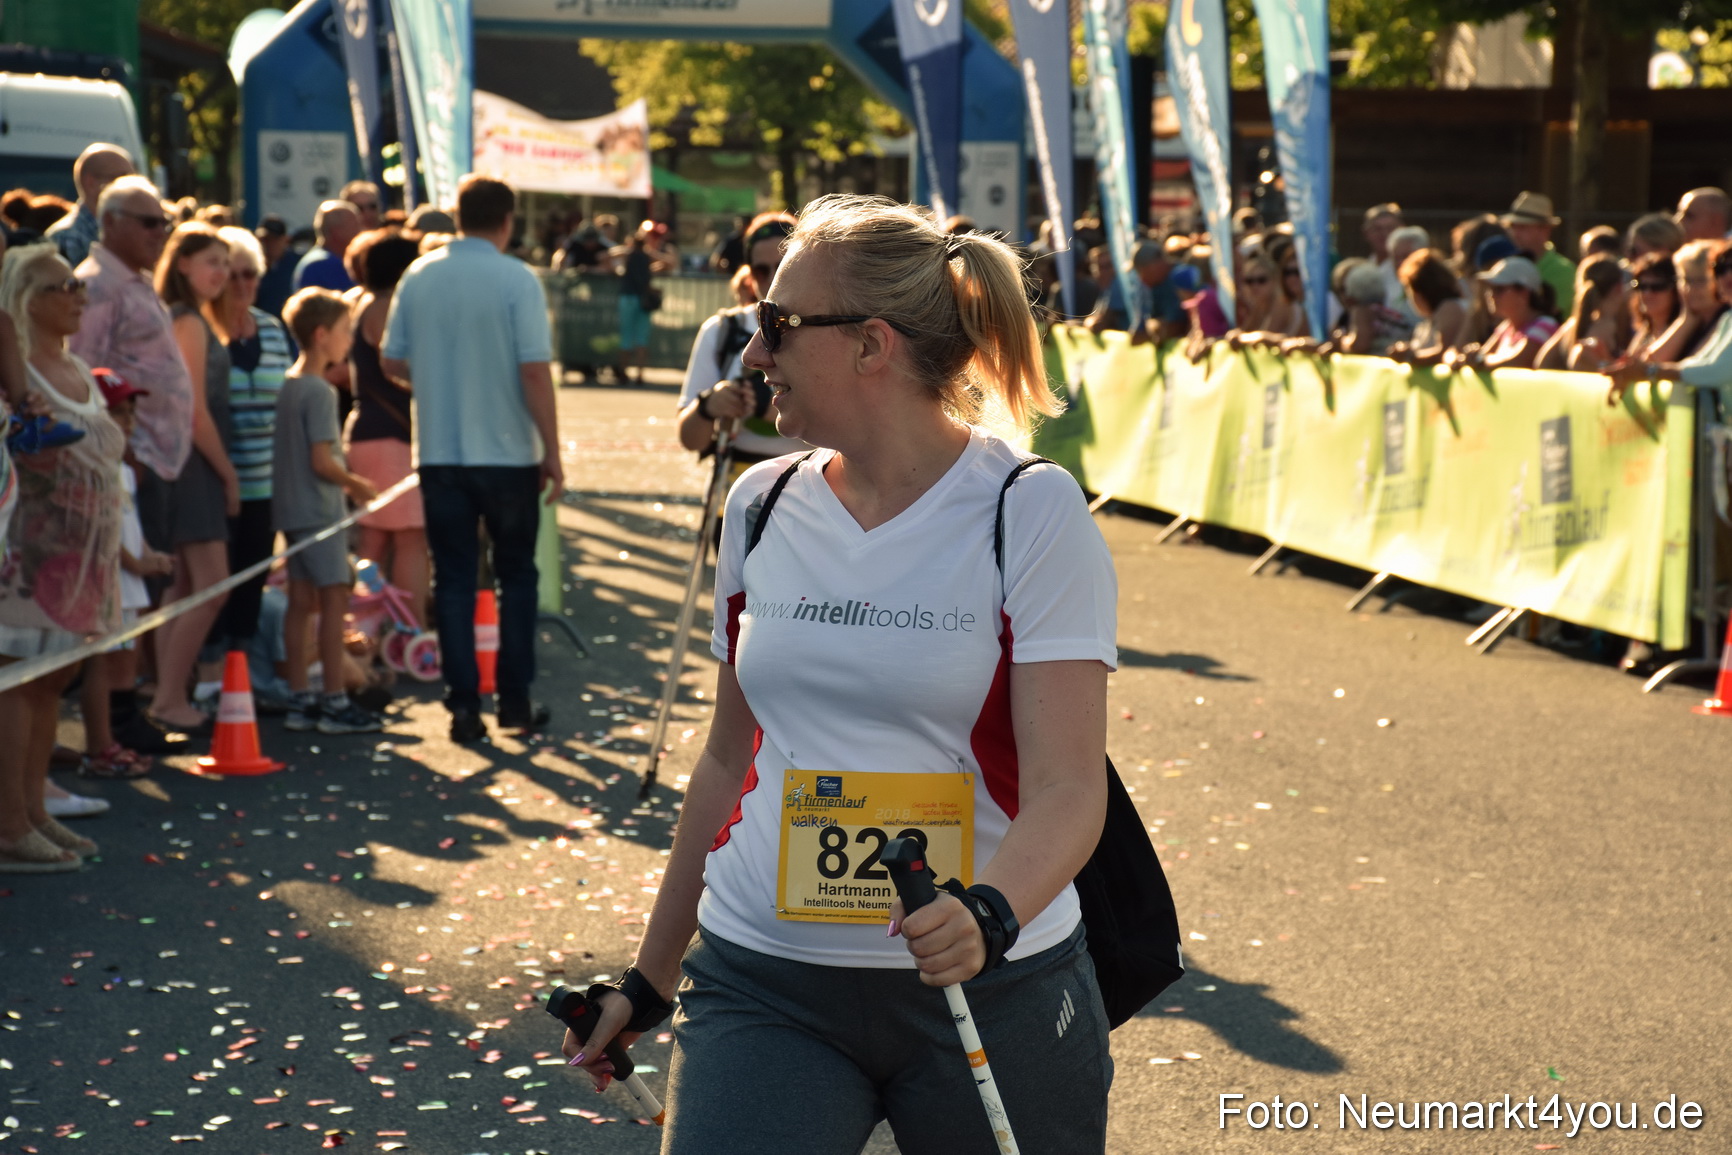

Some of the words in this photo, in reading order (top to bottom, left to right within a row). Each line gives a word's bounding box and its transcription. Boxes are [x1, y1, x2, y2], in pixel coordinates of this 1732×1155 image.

[749, 596, 976, 632] www.intellitools.de
[804, 794, 868, 808] firmenlauf
[791, 814, 838, 828] walken
[874, 808, 911, 820] 2018
[818, 882, 891, 897] Hartmann
[803, 897, 855, 909] Intellitools
[858, 898, 893, 909] Neuma
